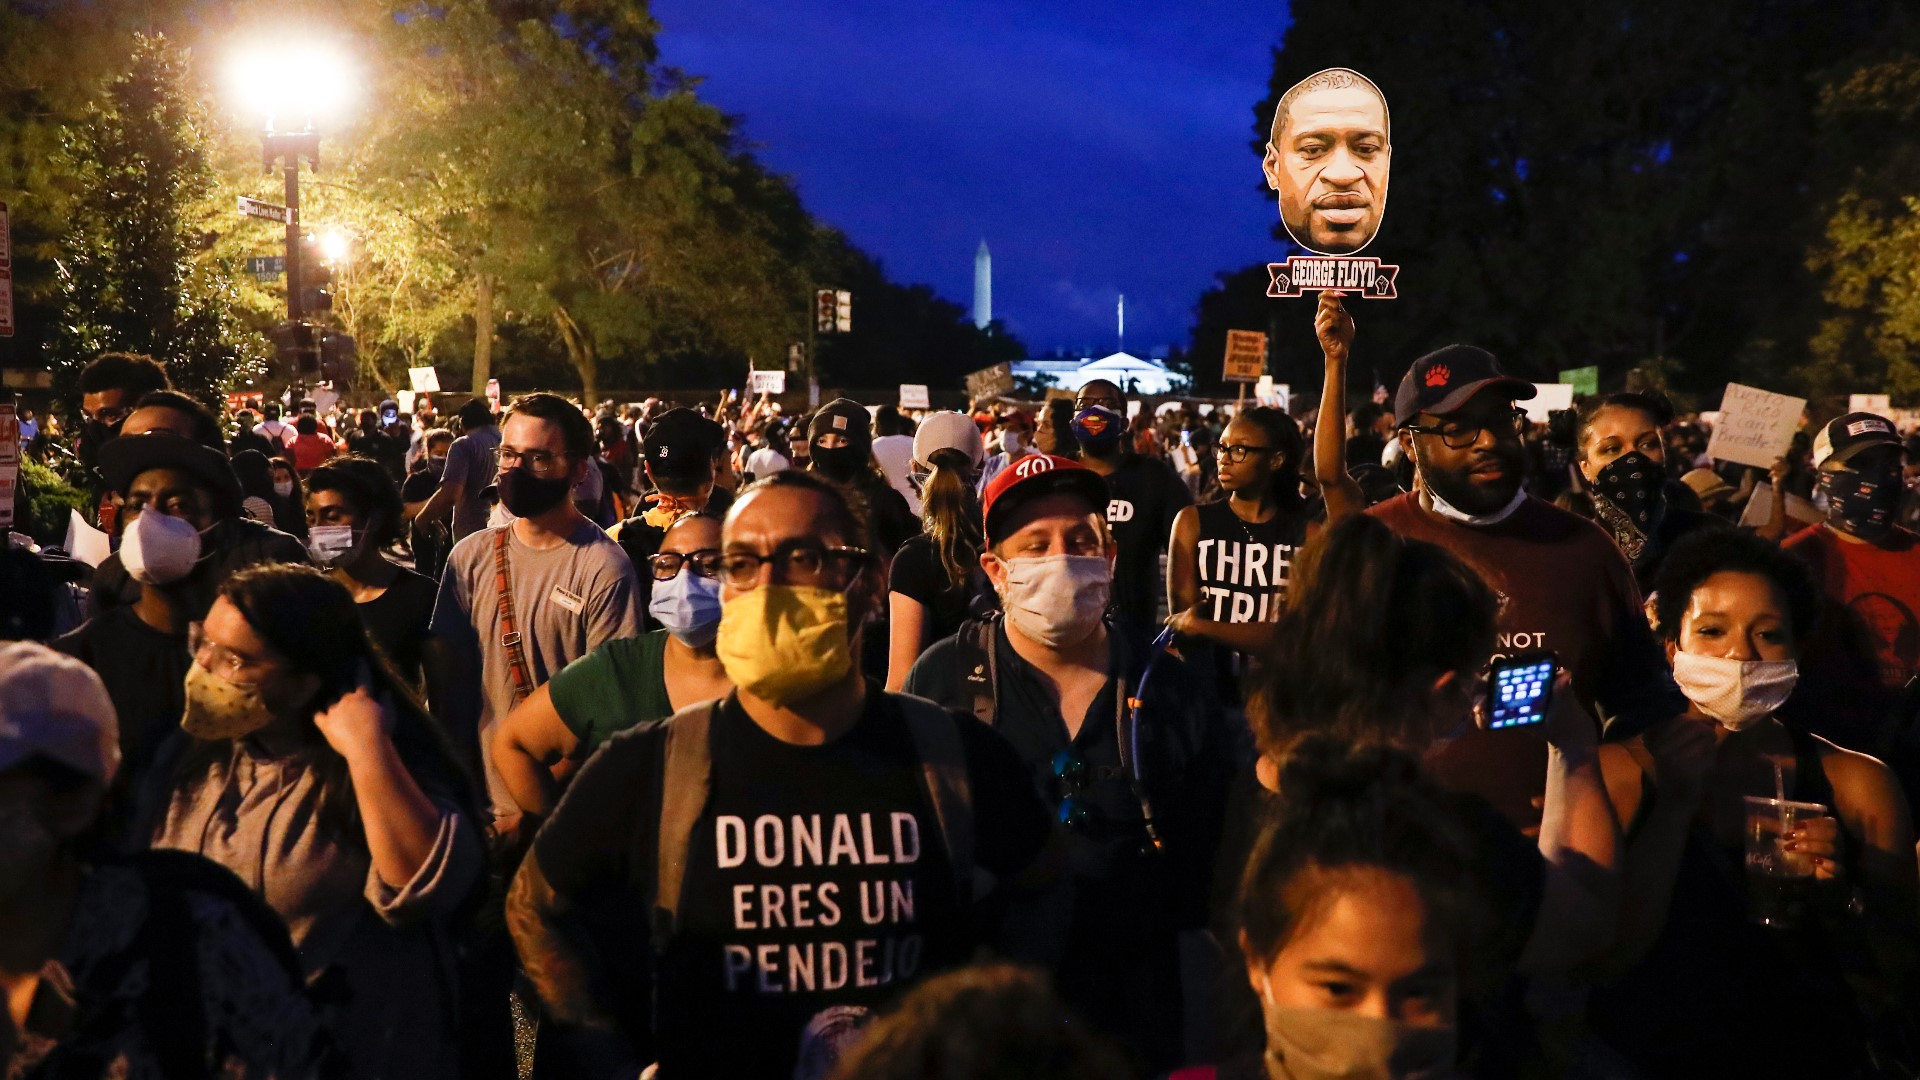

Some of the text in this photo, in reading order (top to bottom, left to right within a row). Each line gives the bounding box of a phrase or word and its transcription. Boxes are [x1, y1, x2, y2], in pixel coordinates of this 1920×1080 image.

[255, 258, 265, 272] H
[1291, 260, 1376, 288] GEORGE FLOYD
[1197, 538, 1304, 588] THRE
[1496, 632, 1546, 648] NOT
[716, 811, 921, 869] DONALD
[733, 879, 915, 930] ERES UN
[724, 934, 924, 993] PENDEJO
